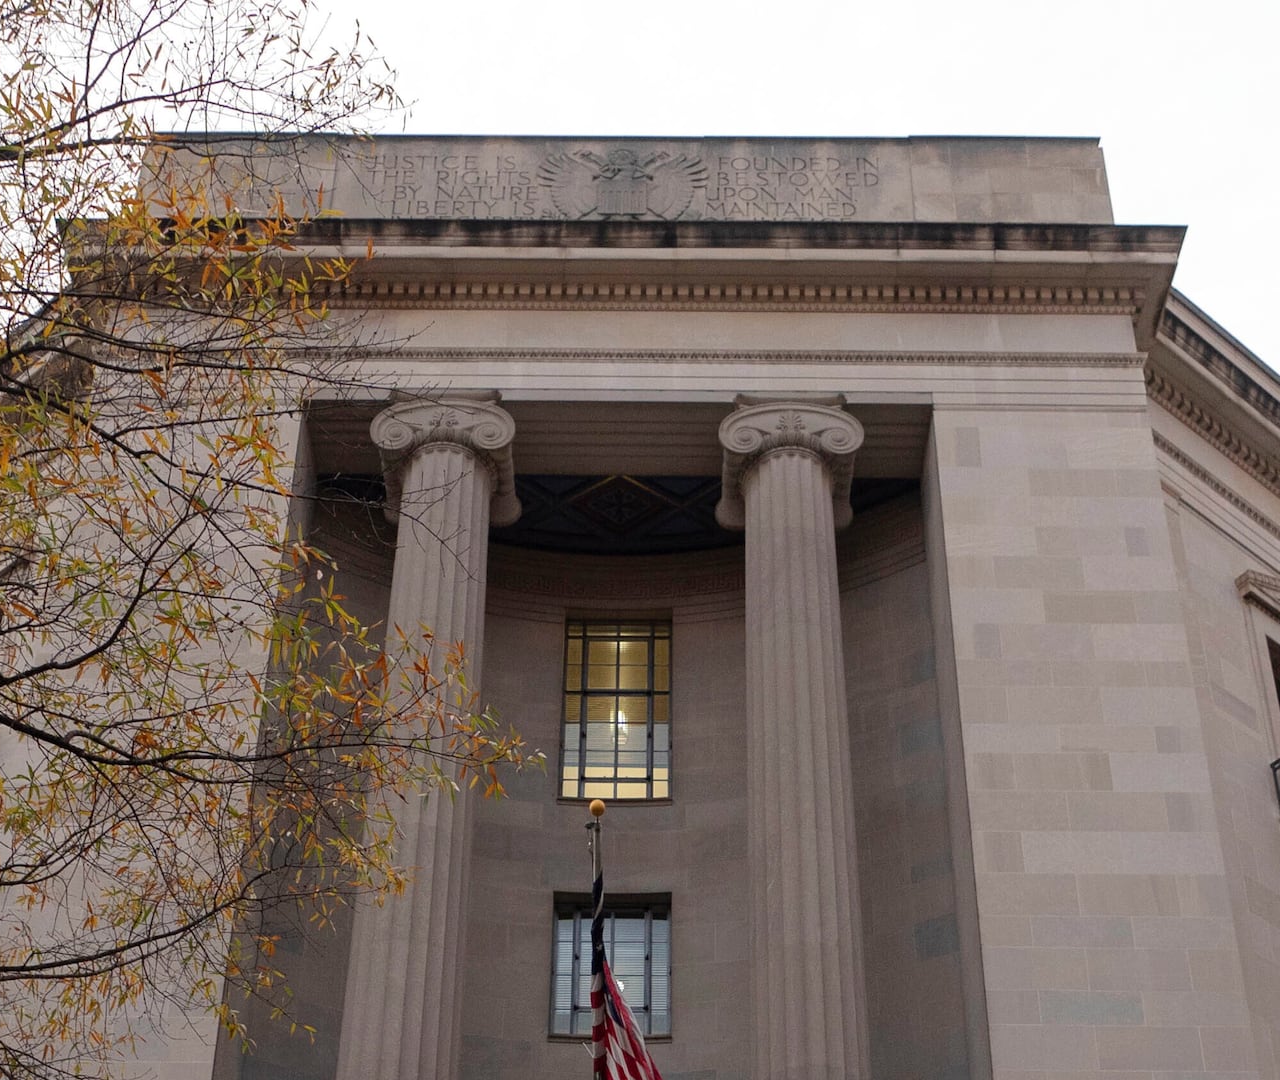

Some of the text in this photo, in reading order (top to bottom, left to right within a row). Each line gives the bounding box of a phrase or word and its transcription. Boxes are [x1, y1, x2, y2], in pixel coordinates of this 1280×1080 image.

[365, 155, 879, 172] JUSTICE IS FOUNDED IN
[368, 170, 879, 187] THE RIGHTS BESTOWED
[393, 185, 423, 200] BY
[437, 185, 539, 200] NATURE
[705, 186, 777, 202] UPON
[391, 200, 857, 217] LIBERTY IS MAINTAINED
